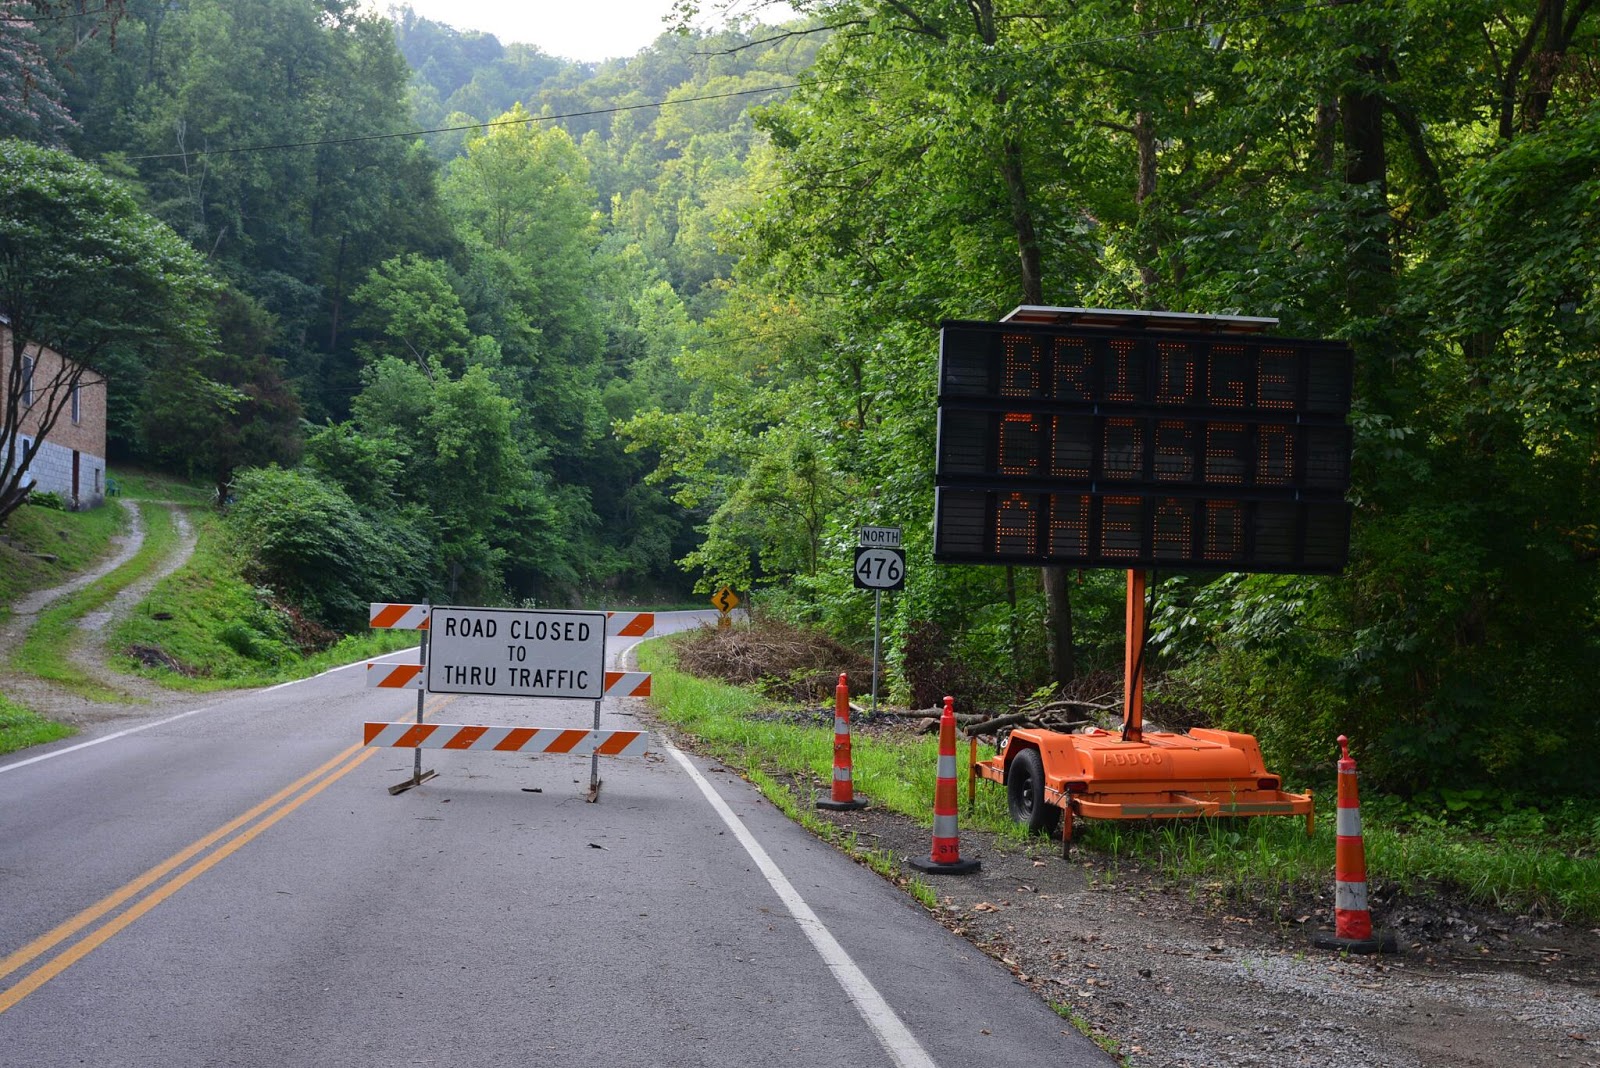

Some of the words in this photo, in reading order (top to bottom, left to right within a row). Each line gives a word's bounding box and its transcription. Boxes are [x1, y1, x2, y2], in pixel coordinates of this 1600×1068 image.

[1000, 335, 1295, 409] BRIDGE
[998, 413, 1294, 485] CLOSED
[863, 530, 899, 543] NORTH
[996, 492, 1243, 560] AHEAD
[858, 557, 900, 581] 476
[445, 617, 497, 638] ROAD
[510, 620, 590, 642] CLOSED
[507, 645, 526, 662] TO
[443, 665, 496, 686] THRU
[508, 668, 589, 690] TRAFFIC
[1103, 752, 1163, 767] ADDCO
